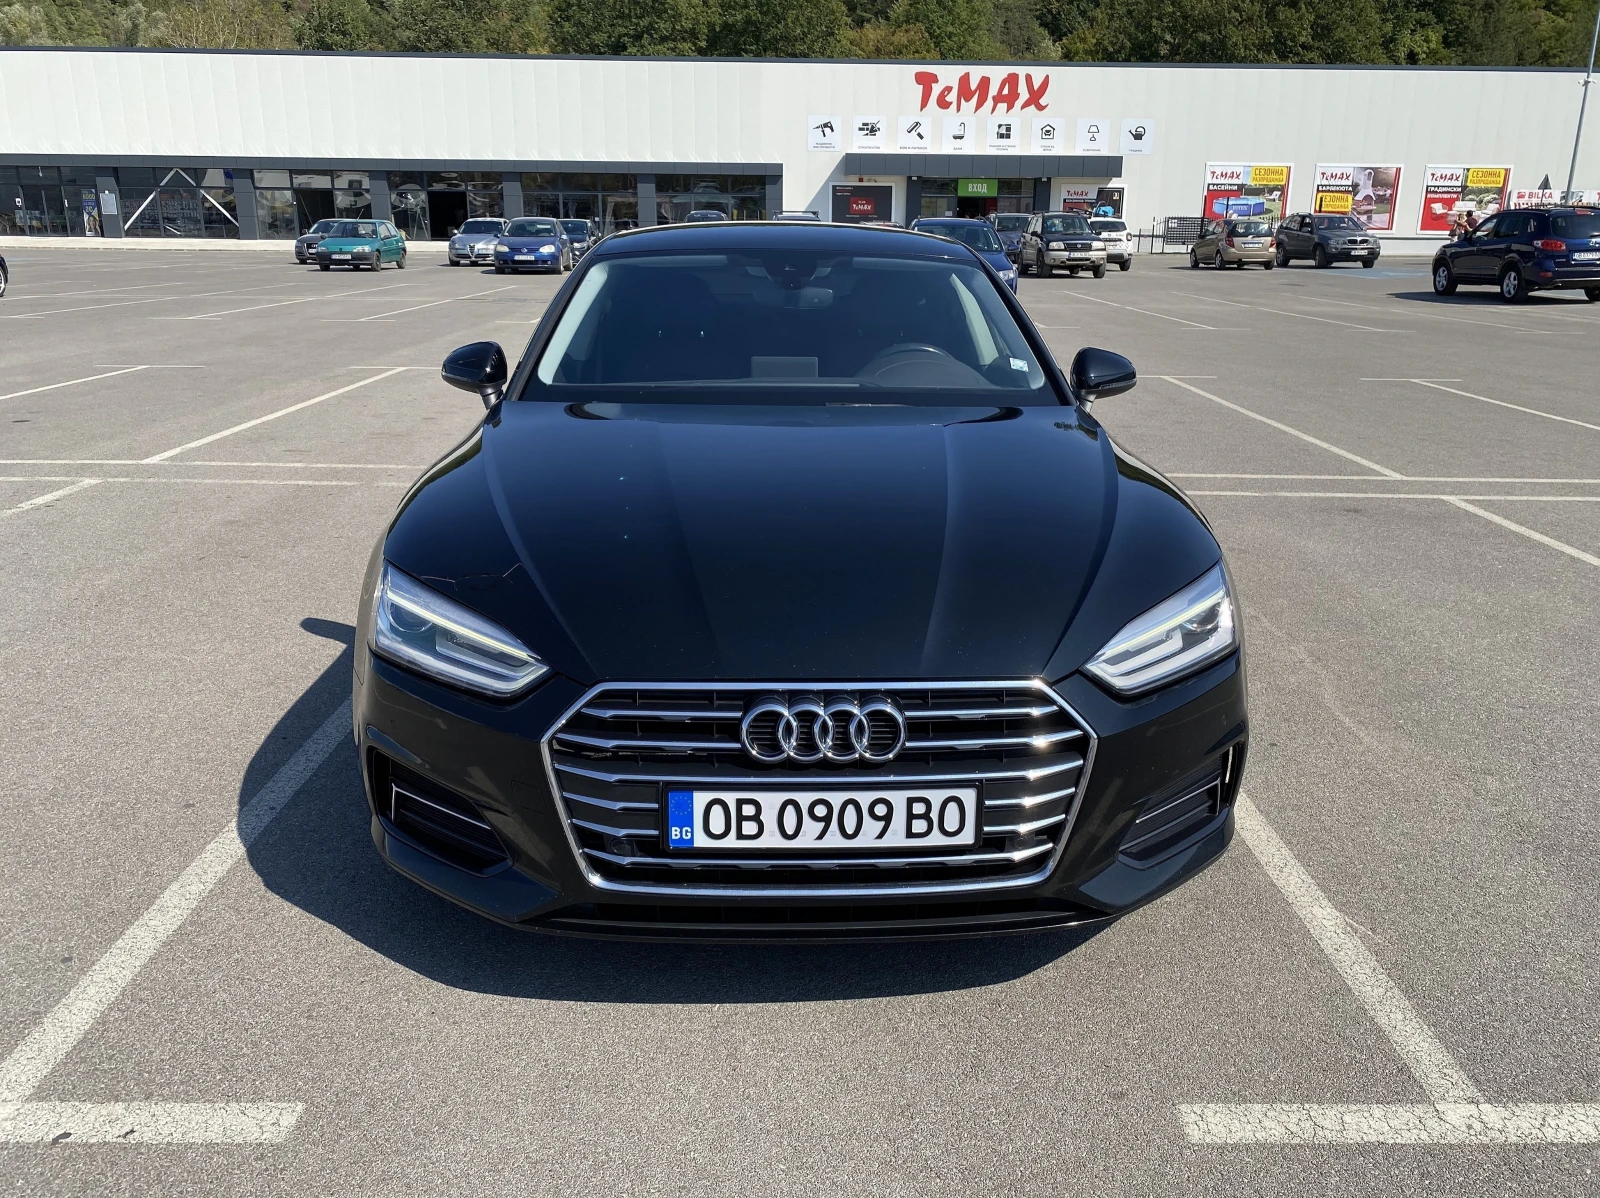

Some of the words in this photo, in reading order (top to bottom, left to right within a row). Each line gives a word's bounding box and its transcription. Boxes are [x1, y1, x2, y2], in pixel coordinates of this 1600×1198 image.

[914, 71, 1050, 115] TeMAX
[1254, 167, 1284, 177] СЕЗОННА
[1471, 169, 1501, 179] СЕЗОННА
[968, 183, 988, 194] ВХОД
[1528, 191, 1553, 200] BILKA
[702, 797, 765, 841] OB
[776, 797, 894, 841] 0909
[905, 795, 966, 839] BO
[671, 826, 692, 840] BG
